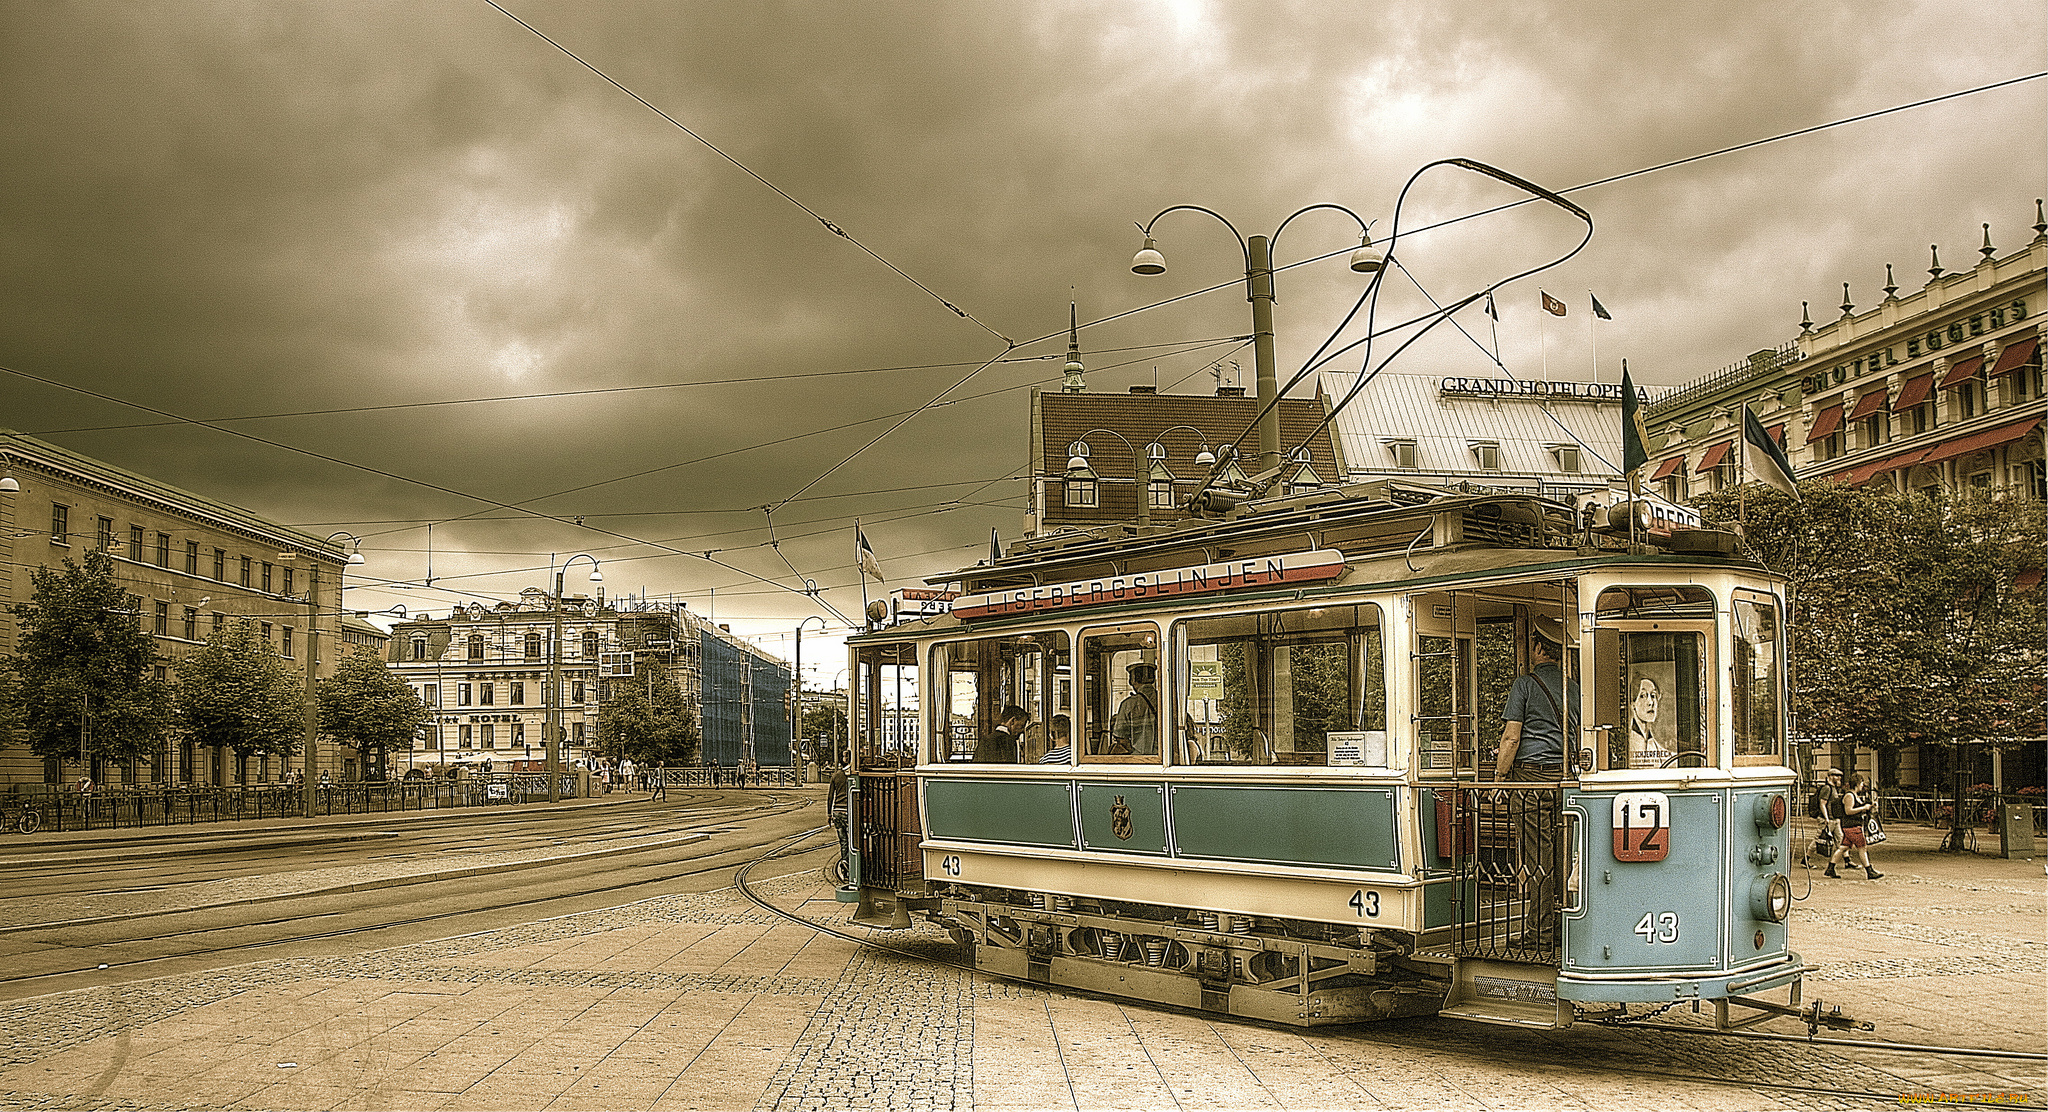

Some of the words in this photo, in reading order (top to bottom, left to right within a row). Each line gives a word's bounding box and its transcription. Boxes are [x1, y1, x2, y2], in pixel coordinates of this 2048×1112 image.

[1814, 348, 1898, 391] HOTEL
[1908, 300, 2027, 358] EGGERS
[1441, 377, 1514, 394] GRAND
[1519, 380, 1583, 397] HOTEL
[1587, 383, 1649, 399] OPEA
[985, 558, 1286, 614] LISEBERGSLINJEN
[469, 714, 521, 722] HOTEL
[1620, 804, 1660, 851] 12
[942, 855, 961, 876] 43
[1348, 889, 1380, 918] 43
[1634, 911, 1679, 944] 43
